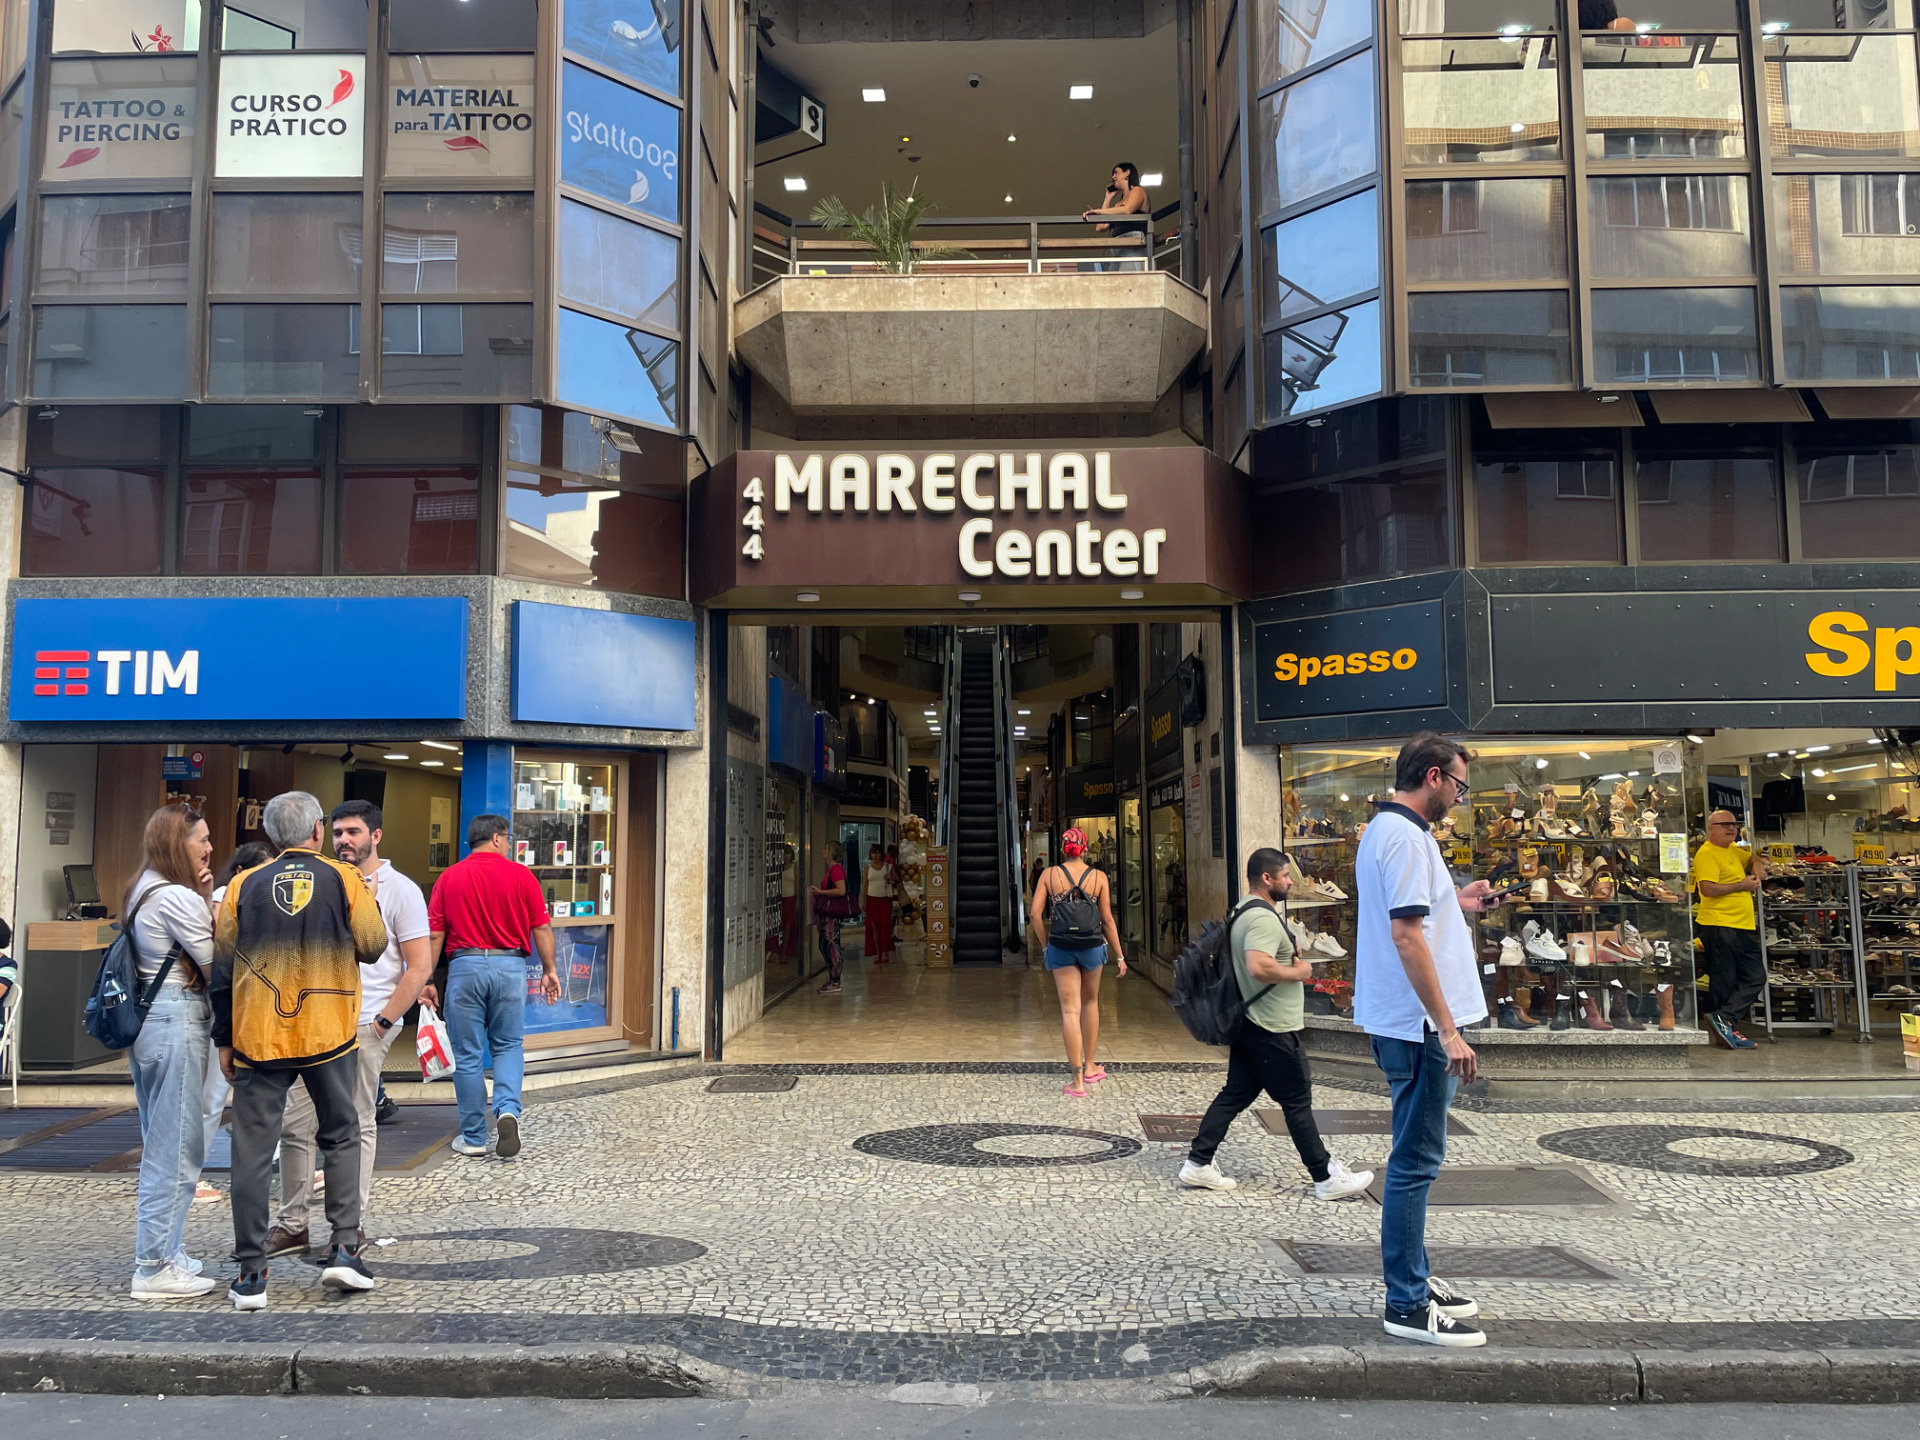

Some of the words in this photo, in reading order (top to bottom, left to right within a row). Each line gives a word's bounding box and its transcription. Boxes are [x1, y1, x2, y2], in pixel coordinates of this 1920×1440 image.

[231, 94, 322, 112] CURSO
[396, 88, 519, 107] MATERIAL
[59, 99, 166, 119] TATTOO
[173, 104, 186, 117] &
[58, 122, 180, 142] PIERCING
[230, 113, 347, 136] PRÁTICO
[394, 121, 429, 134] para
[428, 112, 532, 132] TATTOO
[774, 451, 1129, 515] MARECHAL
[958, 517, 1167, 578] Center
[97, 650, 199, 695] TIM
[1274, 648, 1418, 686] Spasso
[1153, 711, 1172, 748] Spasso
[1084, 782, 1114, 799] Spasso
[573, 963, 591, 974] 12X
